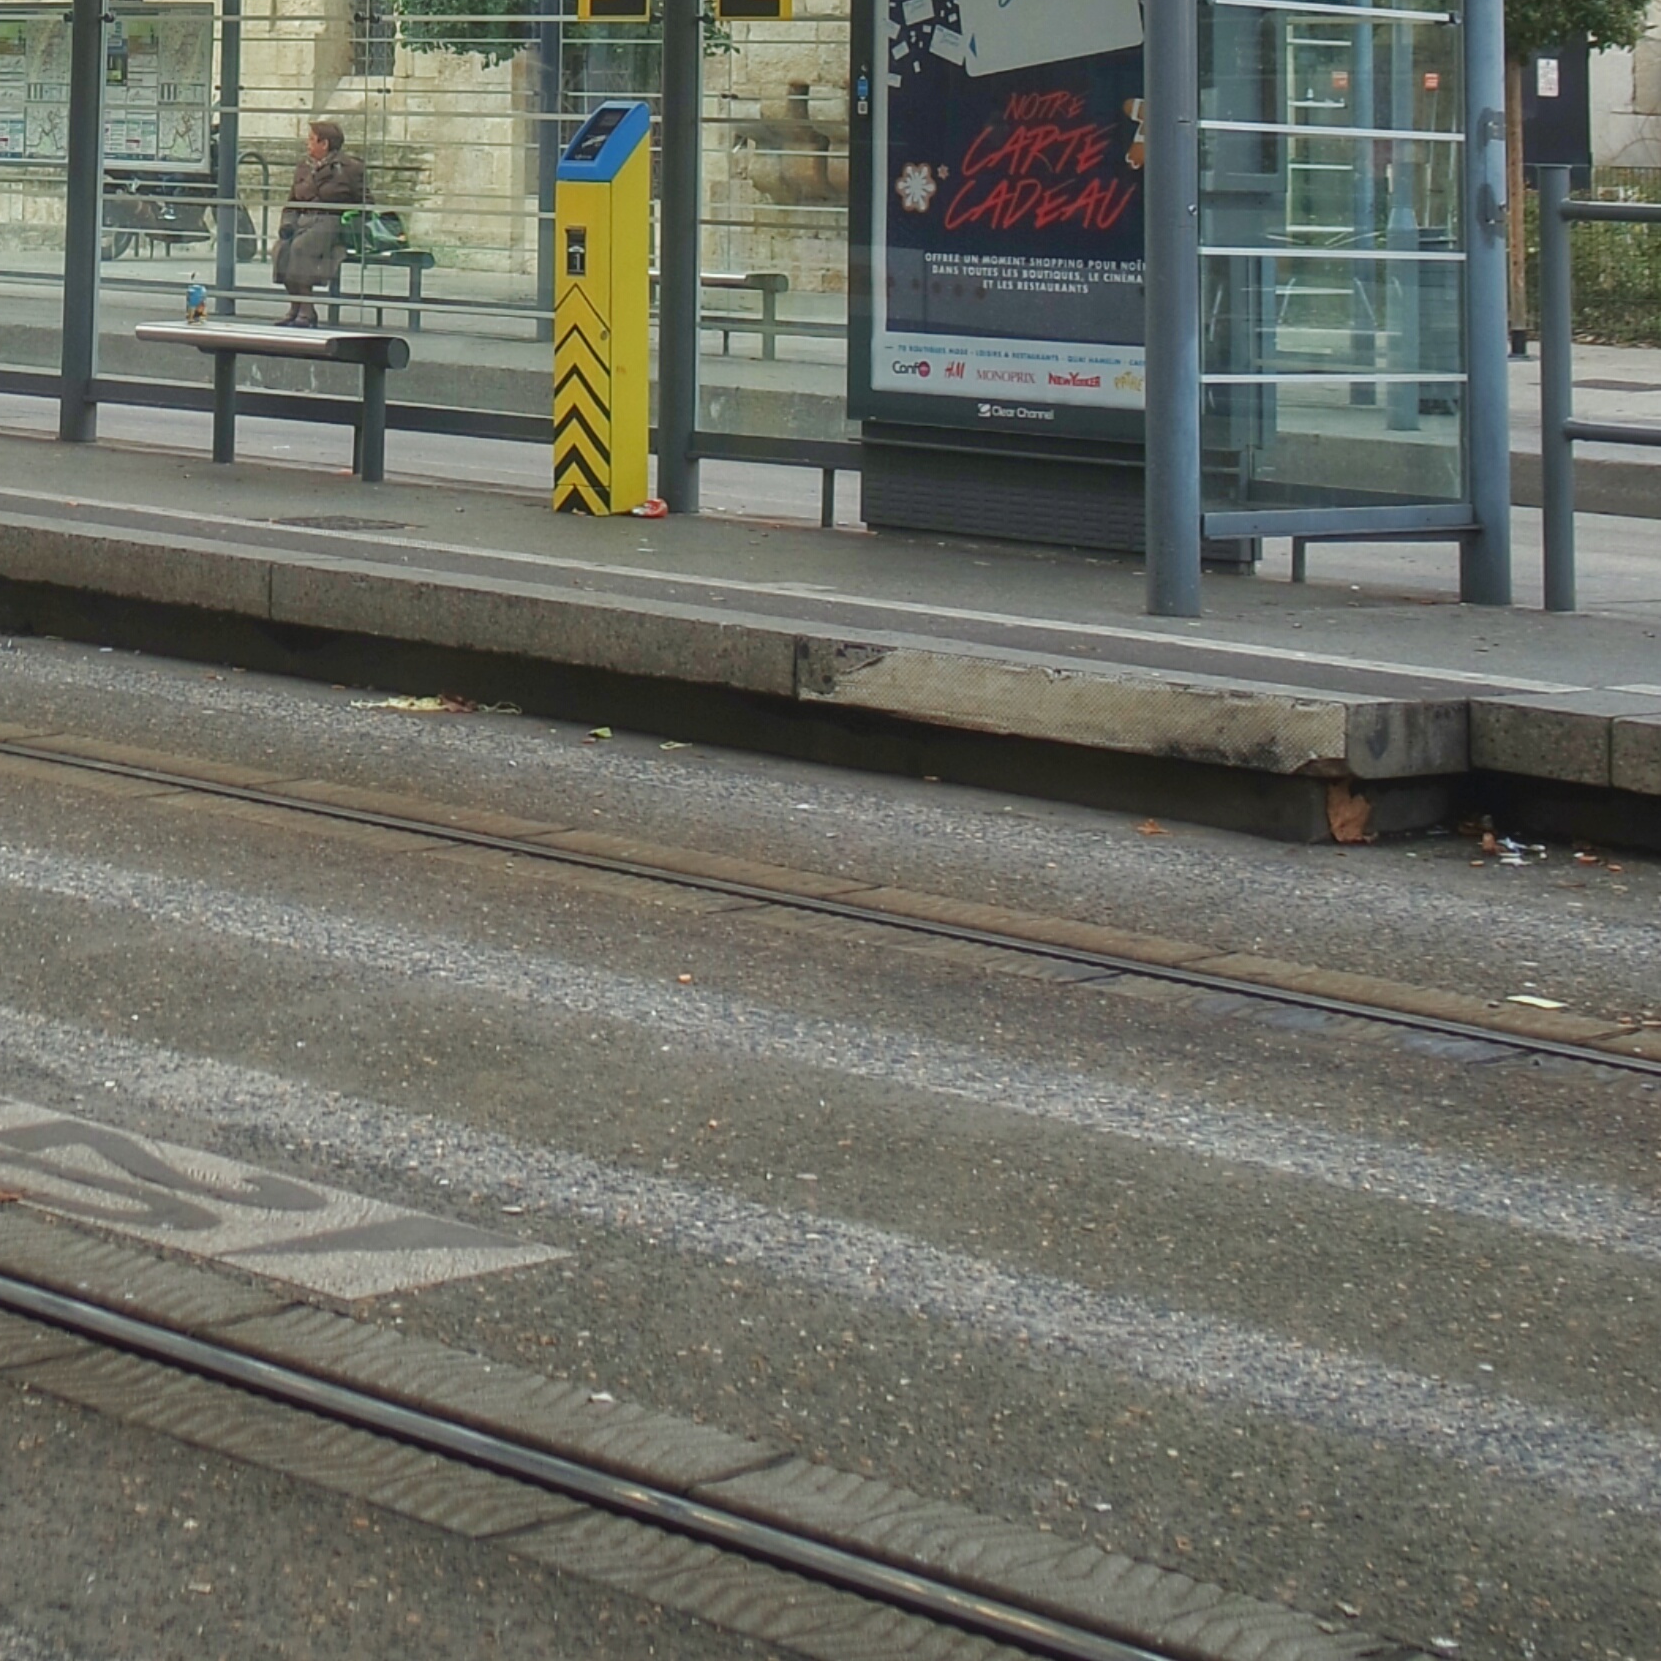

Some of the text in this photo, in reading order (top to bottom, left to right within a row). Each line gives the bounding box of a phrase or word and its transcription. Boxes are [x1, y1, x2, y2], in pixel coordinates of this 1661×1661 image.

[1003, 90, 1086, 120] NOTRE
[962, 123, 1118, 176] CARTE
[945, 177, 1137, 230] CADEAU
[924, 253, 960, 263] OFFREZ
[963, 254, 979, 265] UN
[982, 255, 1026, 267] MOMENT
[1030, 257, 1084, 269] SHOPPING
[1088, 258, 1117, 271] POUR
[932, 265, 959, 275] DANS
[962, 265, 998, 277] TOUTES
[1002, 267, 1018, 278] LES
[1088, 271, 1099, 282] LE
[982, 279, 1088, 293] ET LES RESTAURANTS
[976, 368, 1036, 384] MONOPRIX
